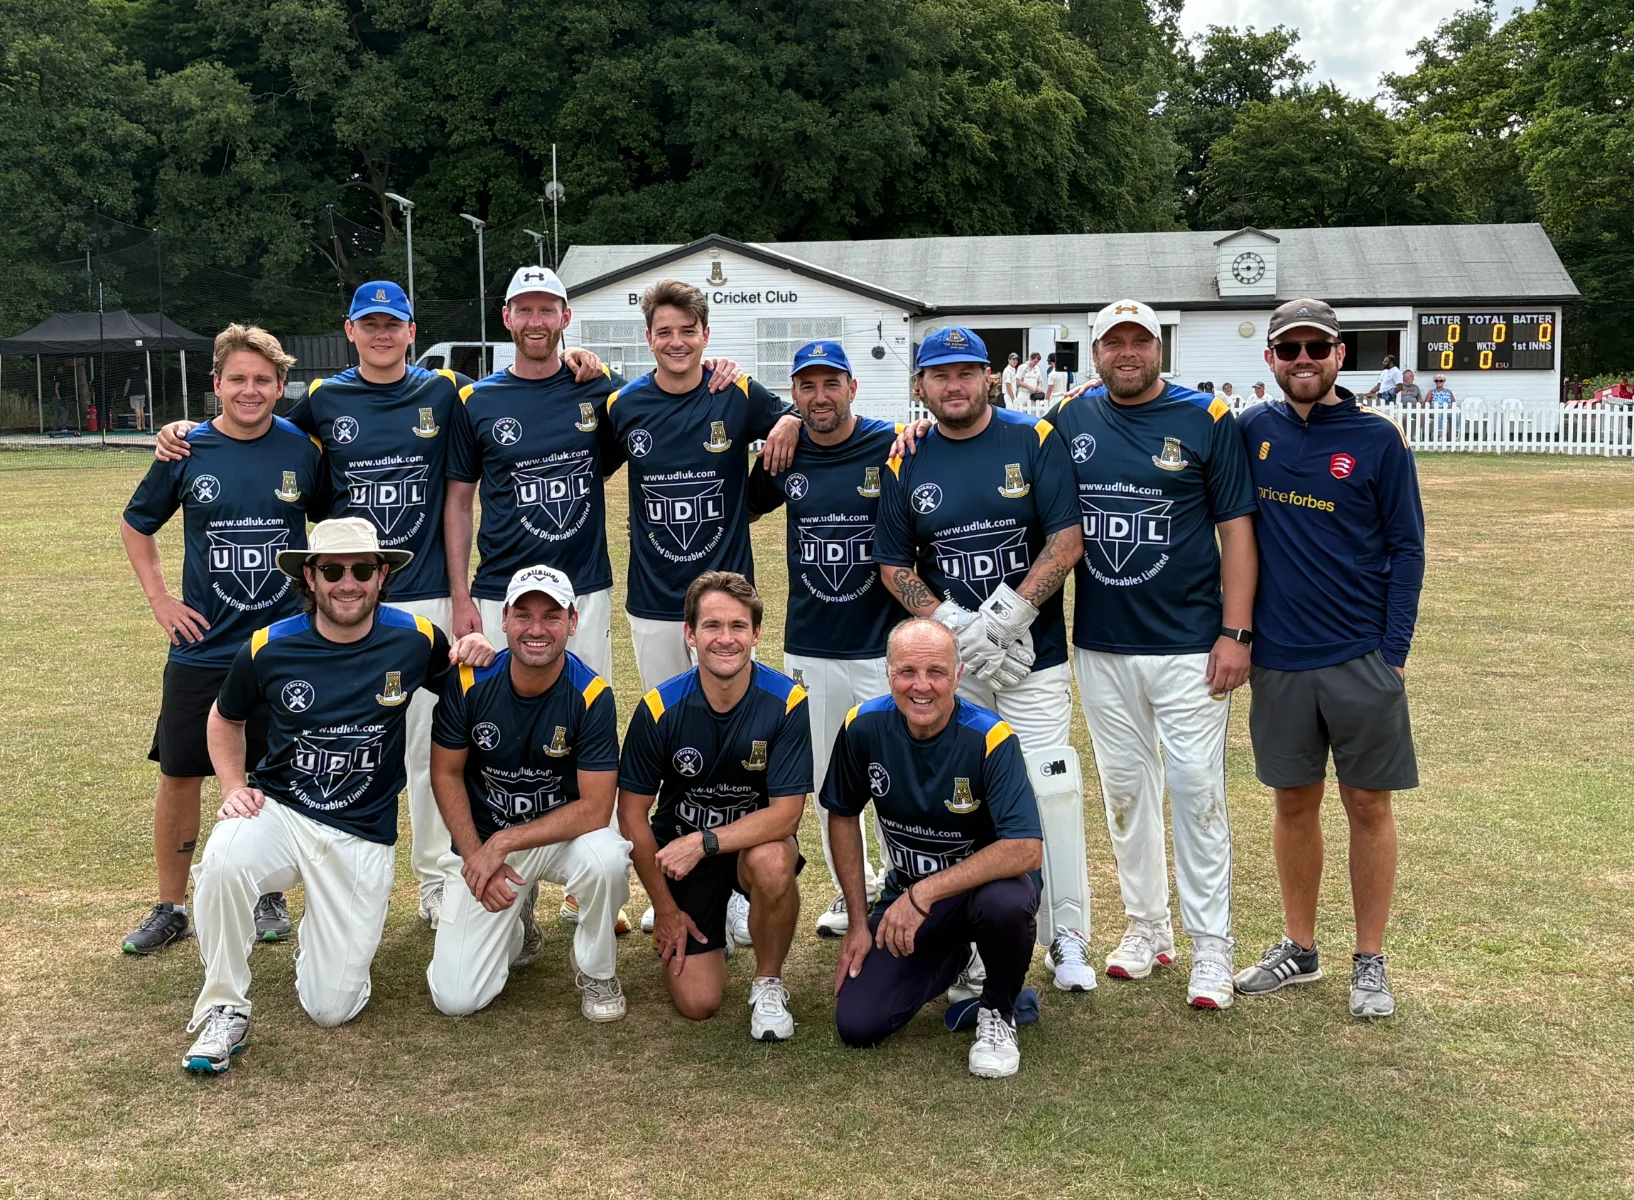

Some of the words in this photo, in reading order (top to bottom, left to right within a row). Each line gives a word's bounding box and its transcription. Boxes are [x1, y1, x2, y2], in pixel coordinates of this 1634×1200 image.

[713, 291, 762, 304] Cricket
[765, 291, 798, 304] Club
[1421, 315, 1461, 325] BATTER
[1467, 315, 1506, 325] TOTAL
[1512, 314, 1552, 324] BATTER
[1447, 324, 1460, 343] 0
[1492, 324, 1506, 343] 0
[1538, 323, 1552, 342] 0
[1427, 342, 1454, 351] OVERS
[1476, 342, 1496, 350] WKTS
[1512, 341, 1526, 350] 1st
[1529, 341, 1552, 350] INNS
[1440, 350, 1454, 369] 0
[1479, 350, 1493, 369] 0
[348, 455, 424, 468] www.udluk.com
[515, 449, 590, 469] www.udluk.com
[643, 470, 716, 481] www.udluk.com
[1079, 482, 1163, 496] www.udluk.com
[210, 517, 284, 528] www.udluk.com
[407, 512, 425, 537] Limited
[520, 515, 540, 536] United
[539, 526, 578, 542] Disposables
[577, 502, 591, 529] Limited
[800, 513, 869, 524] www.udluk.com
[934, 517, 1017, 538] www.udluk.com
[648, 532, 665, 554] United
[664, 549, 706, 563] Disposables
[705, 526, 724, 553] Limited
[520, 569, 560, 584] Callaway
[1095, 570, 1142, 586] Disposables
[1143, 553, 1169, 580] Limited
[212, 581, 232, 604] United
[230, 598, 273, 612] Disposables
[273, 576, 292, 603] Limited
[801, 573, 817, 595] United
[816, 590, 858, 603] Disposables
[857, 570, 877, 595] Limited
[1040, 759, 1067, 777] GM
[299, 792, 348, 811] Disposables
[347, 775, 373, 804] Limited
